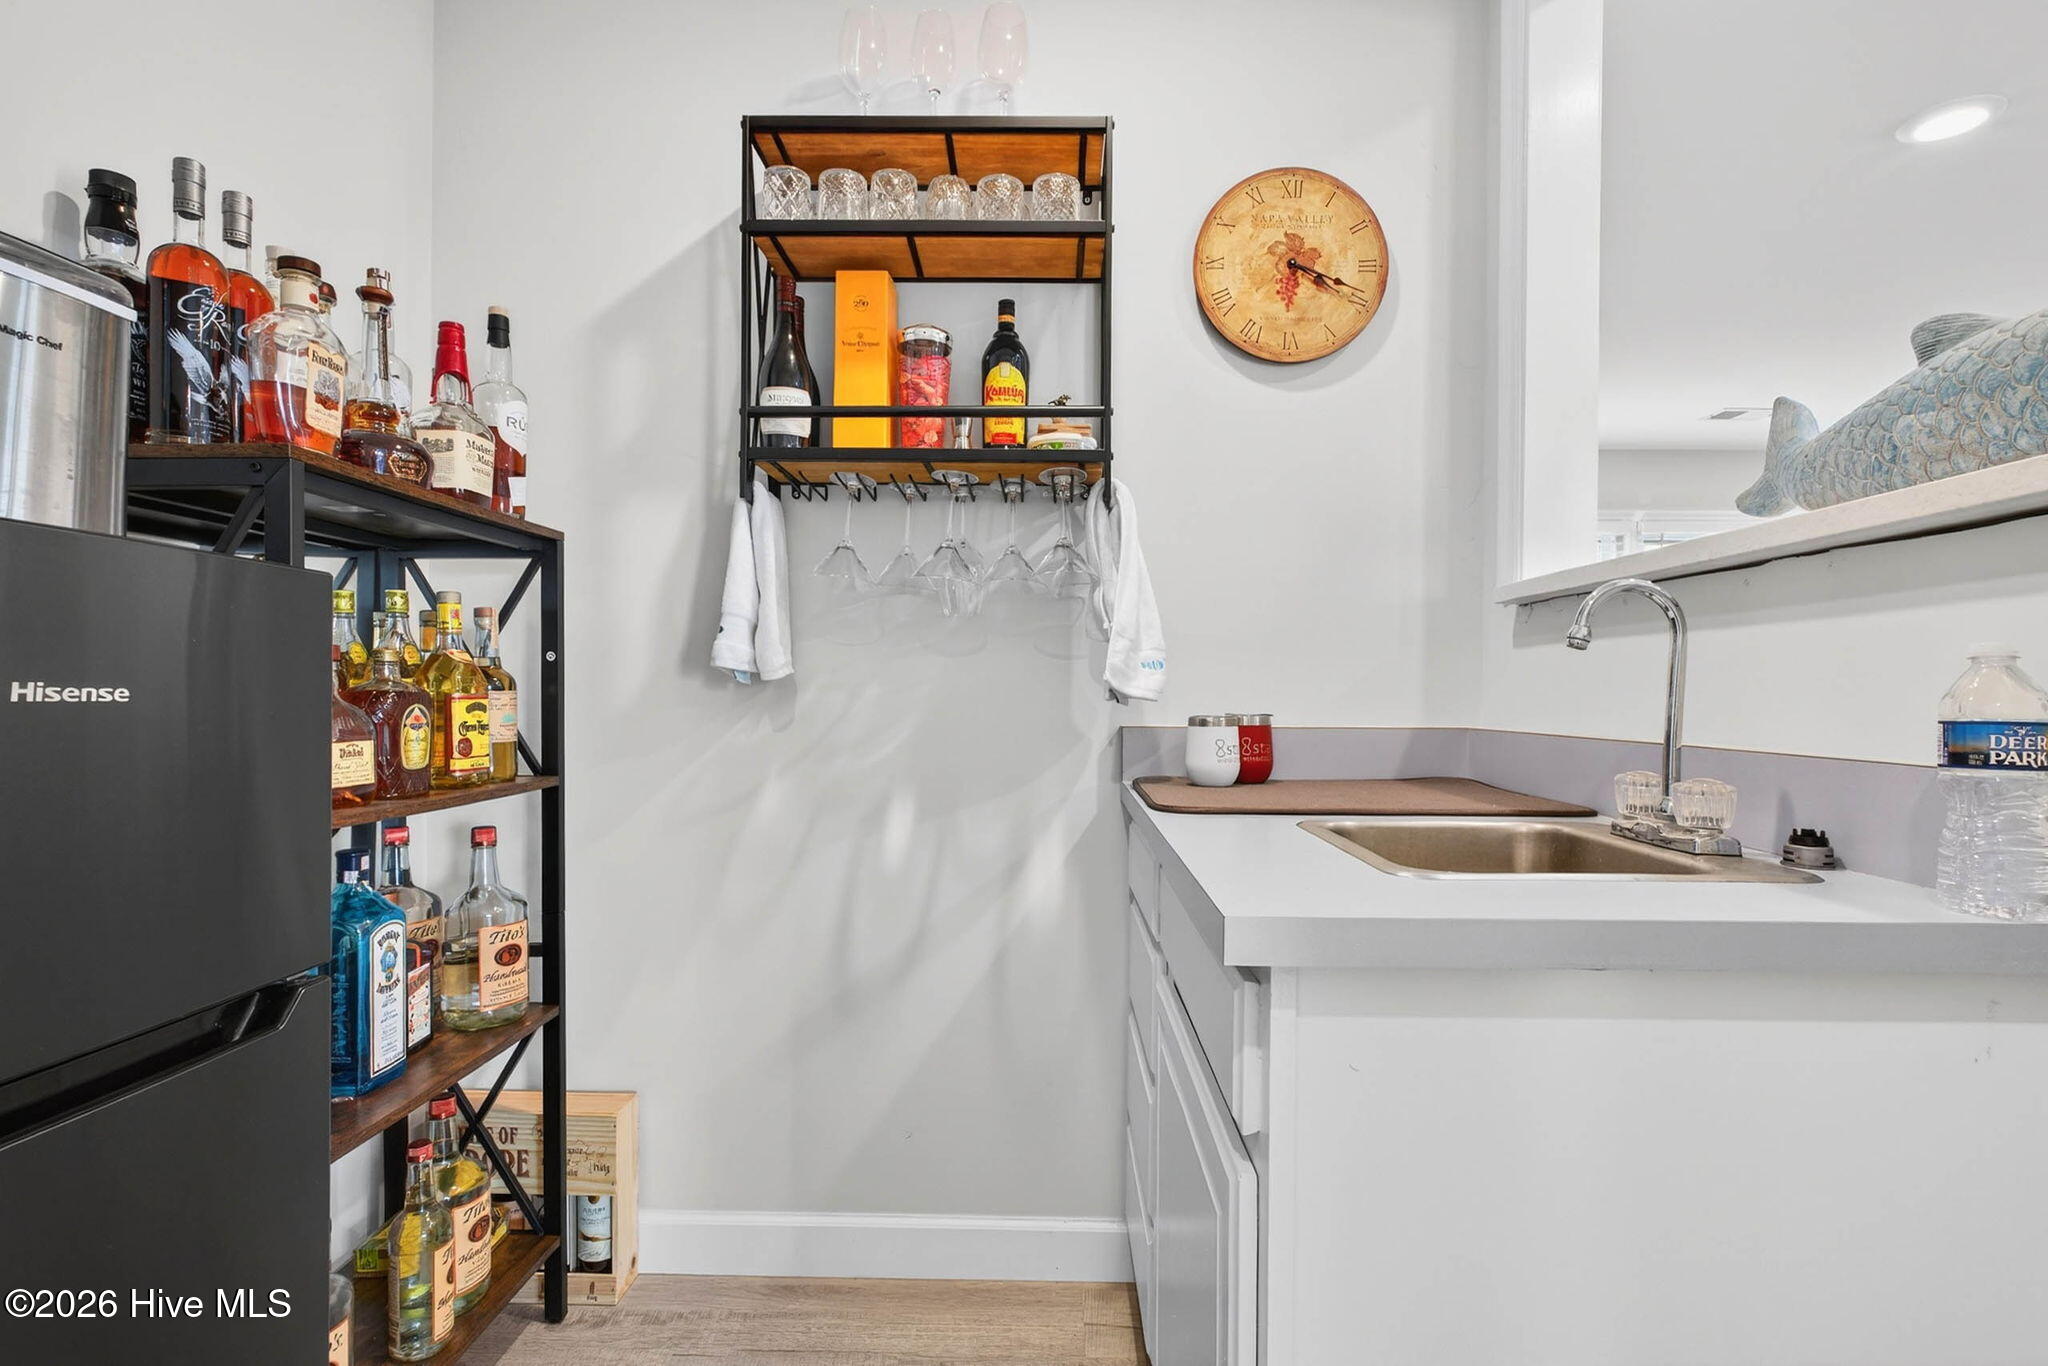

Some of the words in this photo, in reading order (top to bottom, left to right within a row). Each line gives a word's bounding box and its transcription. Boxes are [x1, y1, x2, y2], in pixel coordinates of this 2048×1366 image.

[1245, 186, 1265, 209] XI
[1281, 180, 1303, 199] XII
[1325, 191, 1336, 208] I
[1216, 216, 1236, 234] X
[1251, 214, 1283, 223] NAPA
[1287, 214, 1334, 224] VALLEY
[1349, 220, 1368, 235] II
[1358, 258, 1377, 273] III
[36, 335, 63, 351] Chef
[10, 681, 131, 703] Hisense
[1988, 734, 2048, 750] DEER
[1988, 750, 2048, 768] PARK
[489, 926, 525, 945] Tito's
[500, 1126, 518, 1145] OF
